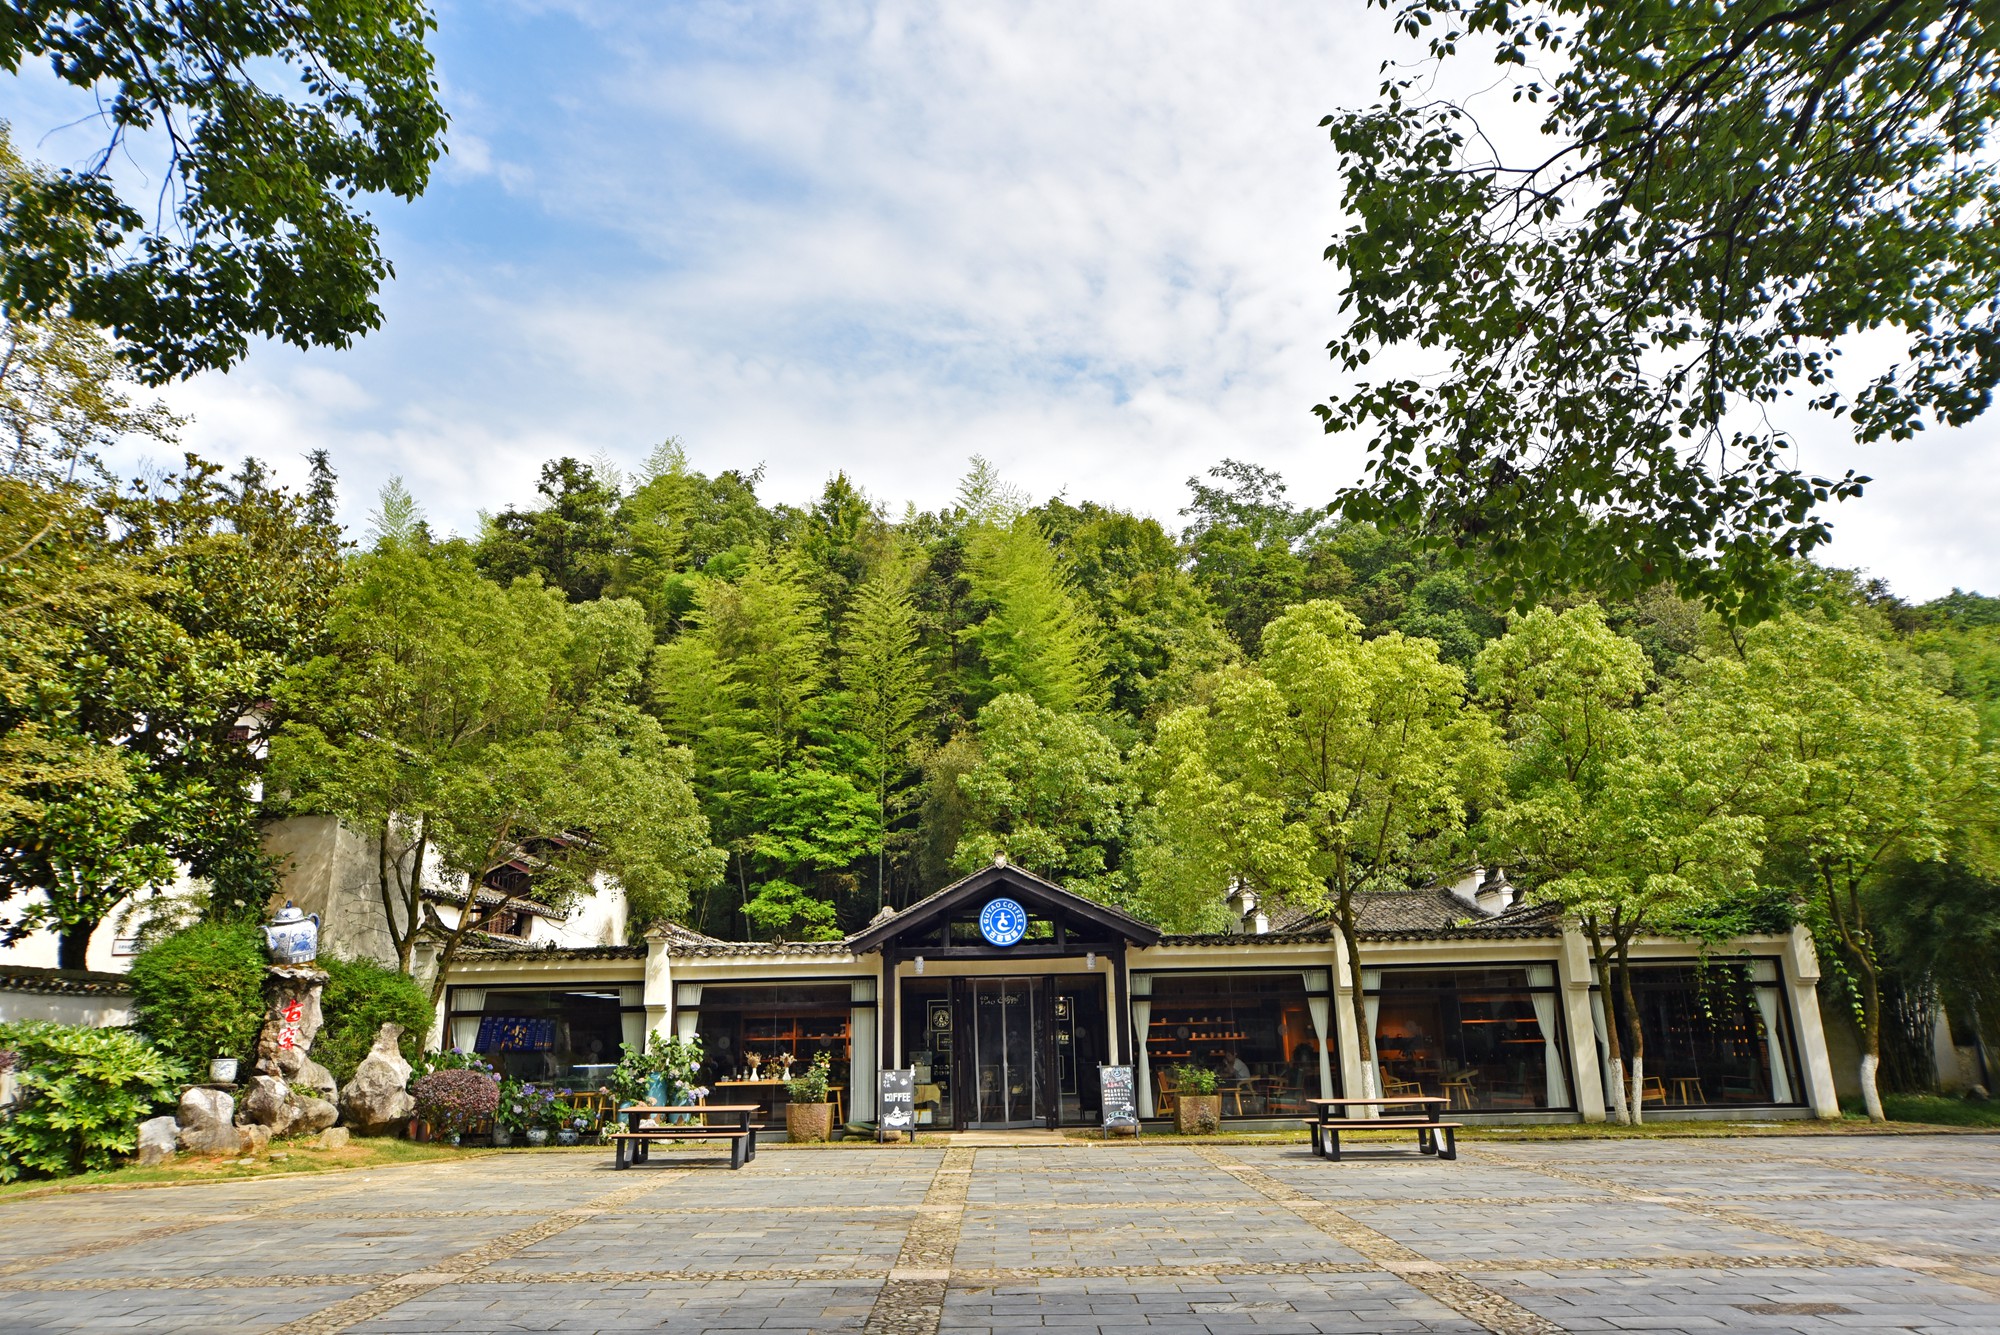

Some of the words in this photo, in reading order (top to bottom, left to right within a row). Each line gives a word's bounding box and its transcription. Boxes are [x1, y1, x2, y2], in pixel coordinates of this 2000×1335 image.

[983, 902, 1001, 924] GUYAO
[1003, 901, 1024, 923] COFFEE
[884, 1092, 911, 1103] COFFEE
